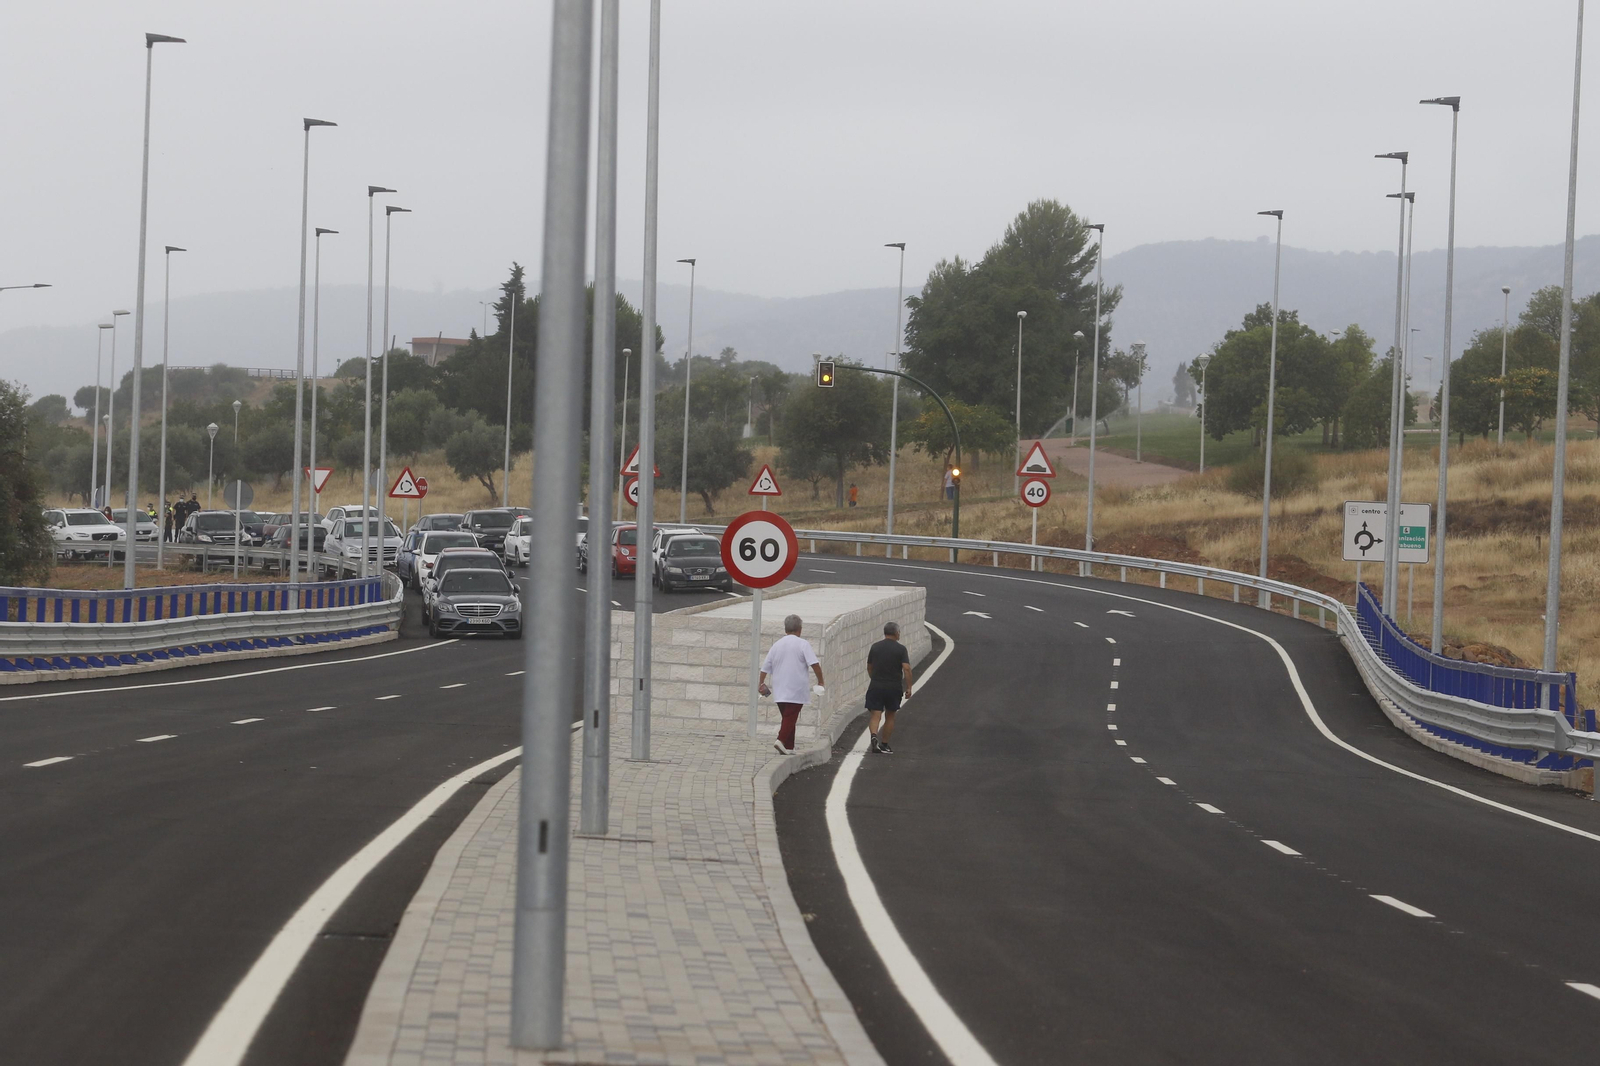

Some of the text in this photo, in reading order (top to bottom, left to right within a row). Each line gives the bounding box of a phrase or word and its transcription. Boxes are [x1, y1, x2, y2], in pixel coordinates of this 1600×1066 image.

[631, 487, 638, 496] 4
[1027, 487, 1044, 497] 40
[739, 537, 780, 563] 60
